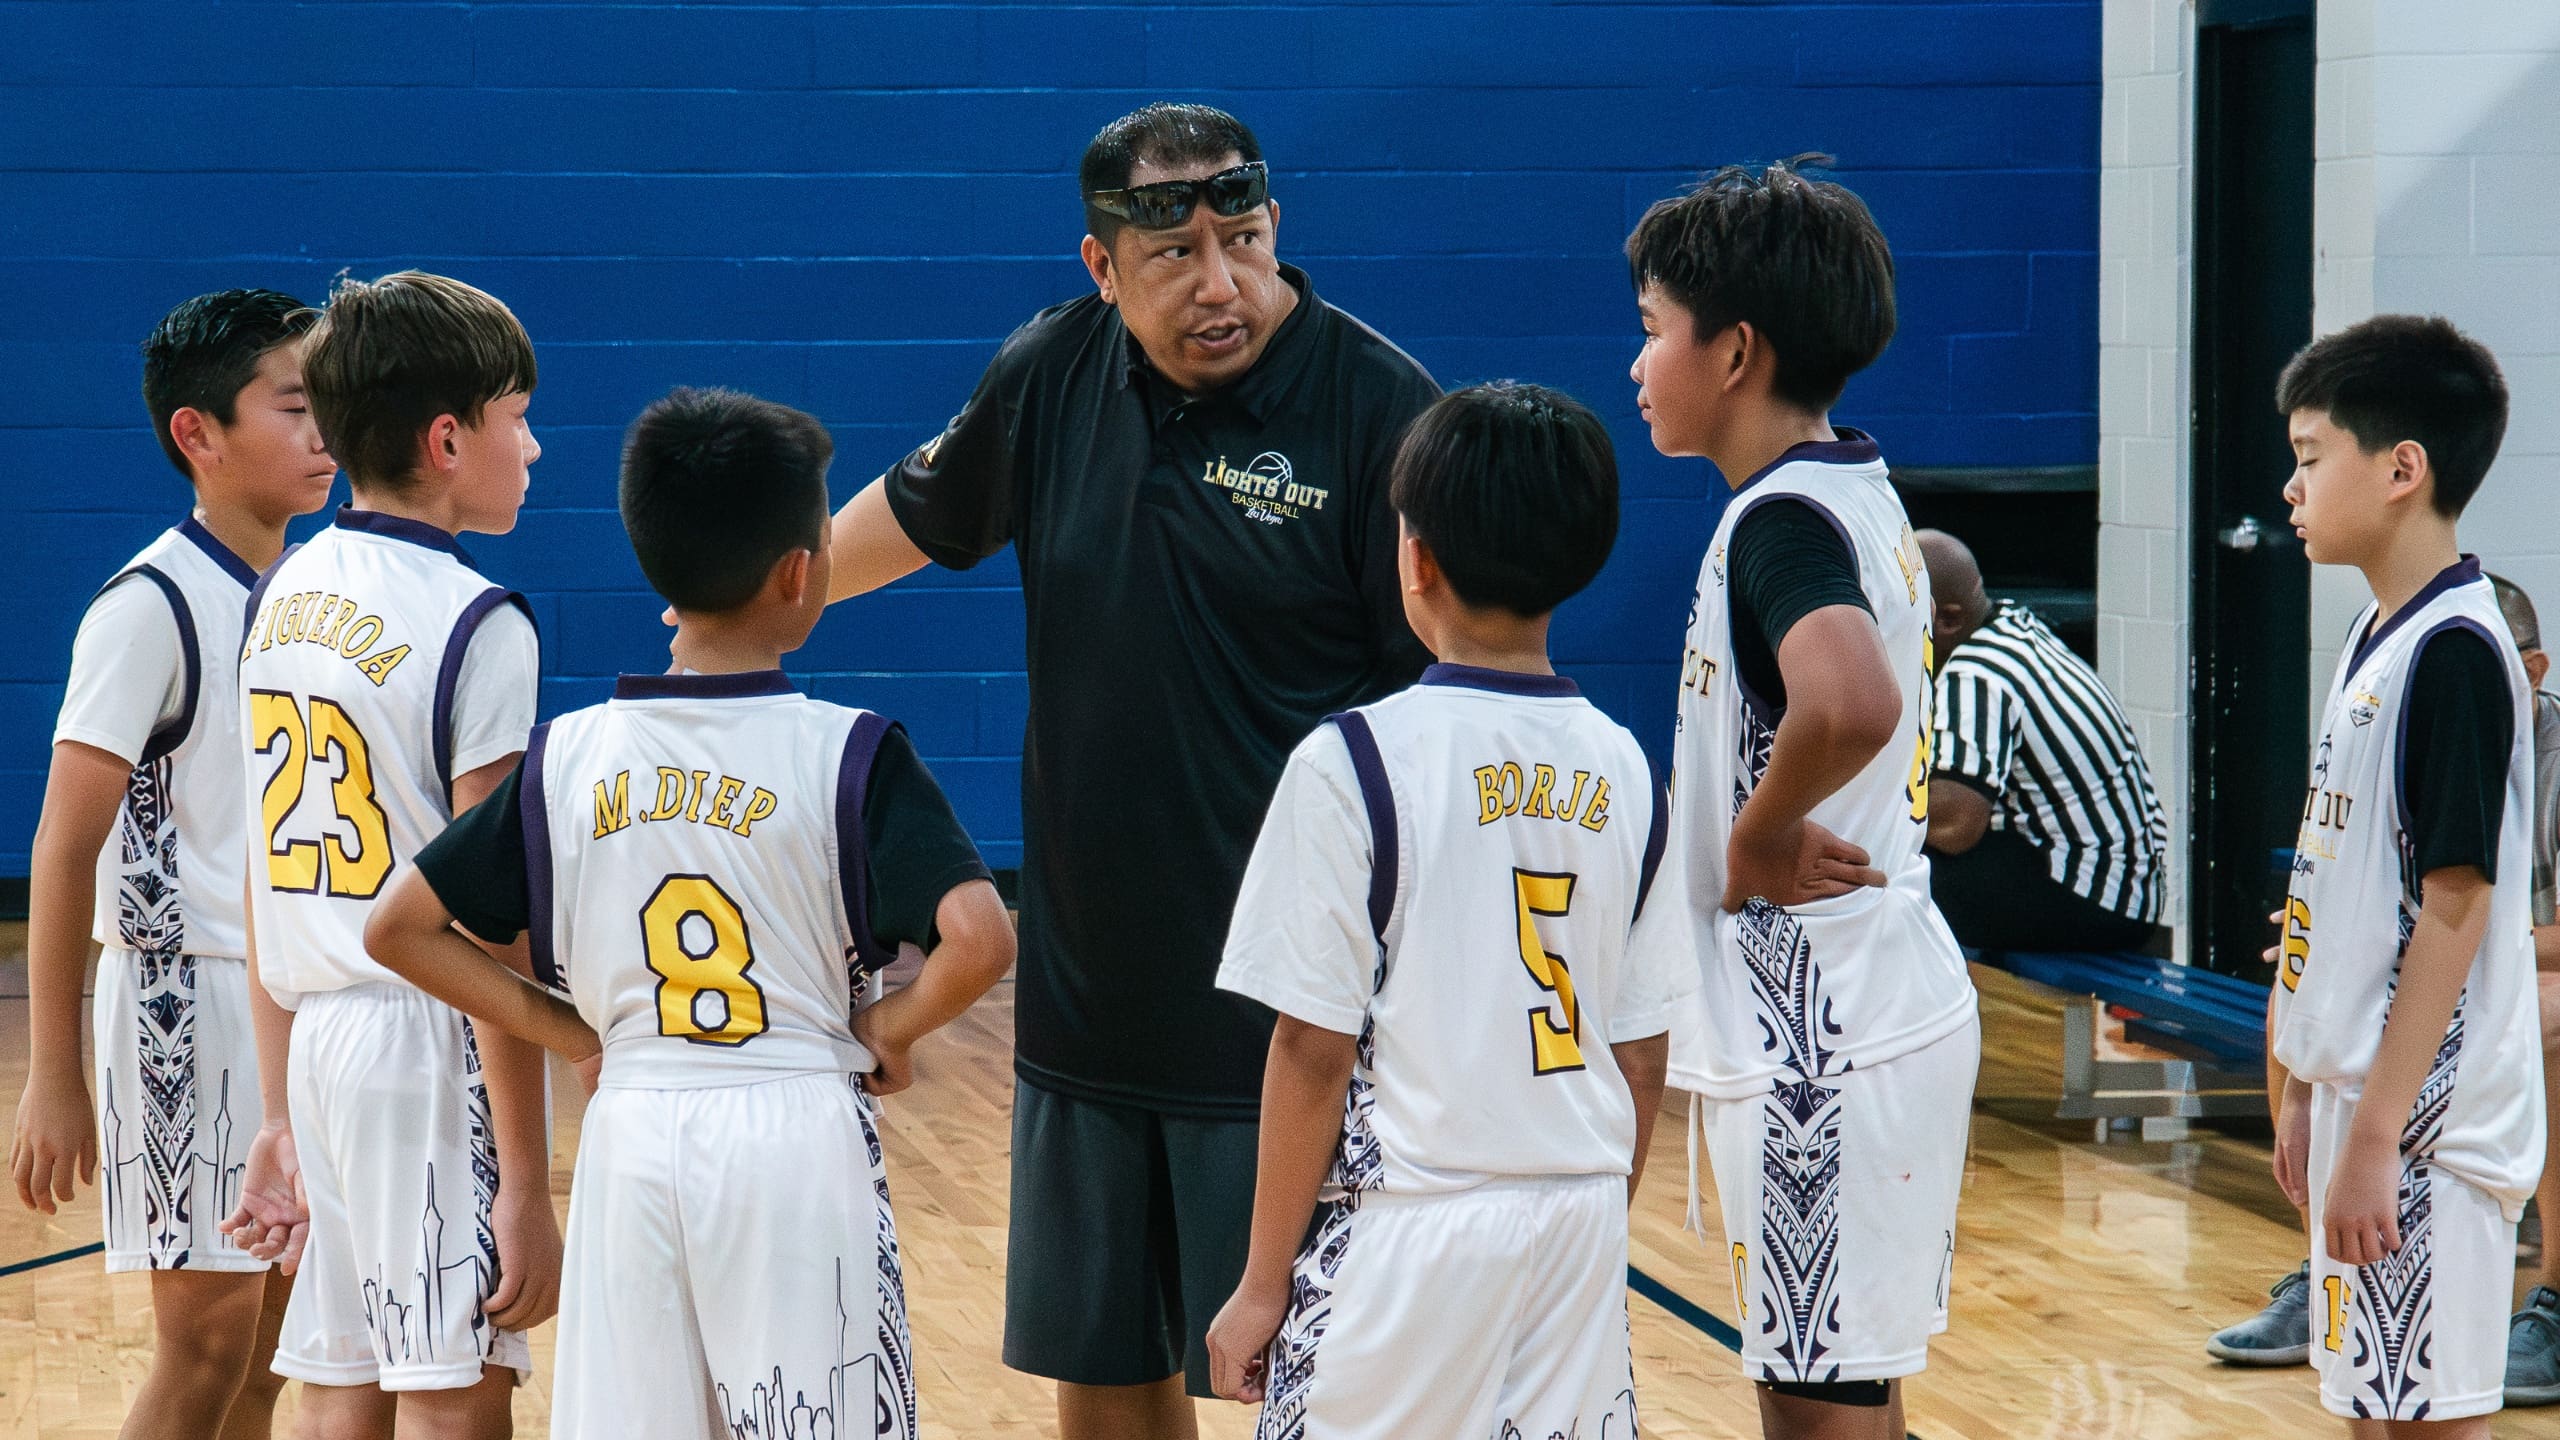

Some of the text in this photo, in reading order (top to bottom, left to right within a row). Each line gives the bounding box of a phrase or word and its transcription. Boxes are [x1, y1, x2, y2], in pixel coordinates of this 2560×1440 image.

[1203, 456, 1328, 510] LIGHTS OUT
[1231, 492, 1299, 519] BASKETBALL
[1245, 507, 1283, 525] Las Vegas
[249, 688, 396, 900] 23
[593, 766, 777, 840] M.DIEP
[1474, 761, 1611, 833] BORJE
[639, 873, 769, 1048] 8
[1512, 866, 1586, 1076] 5
